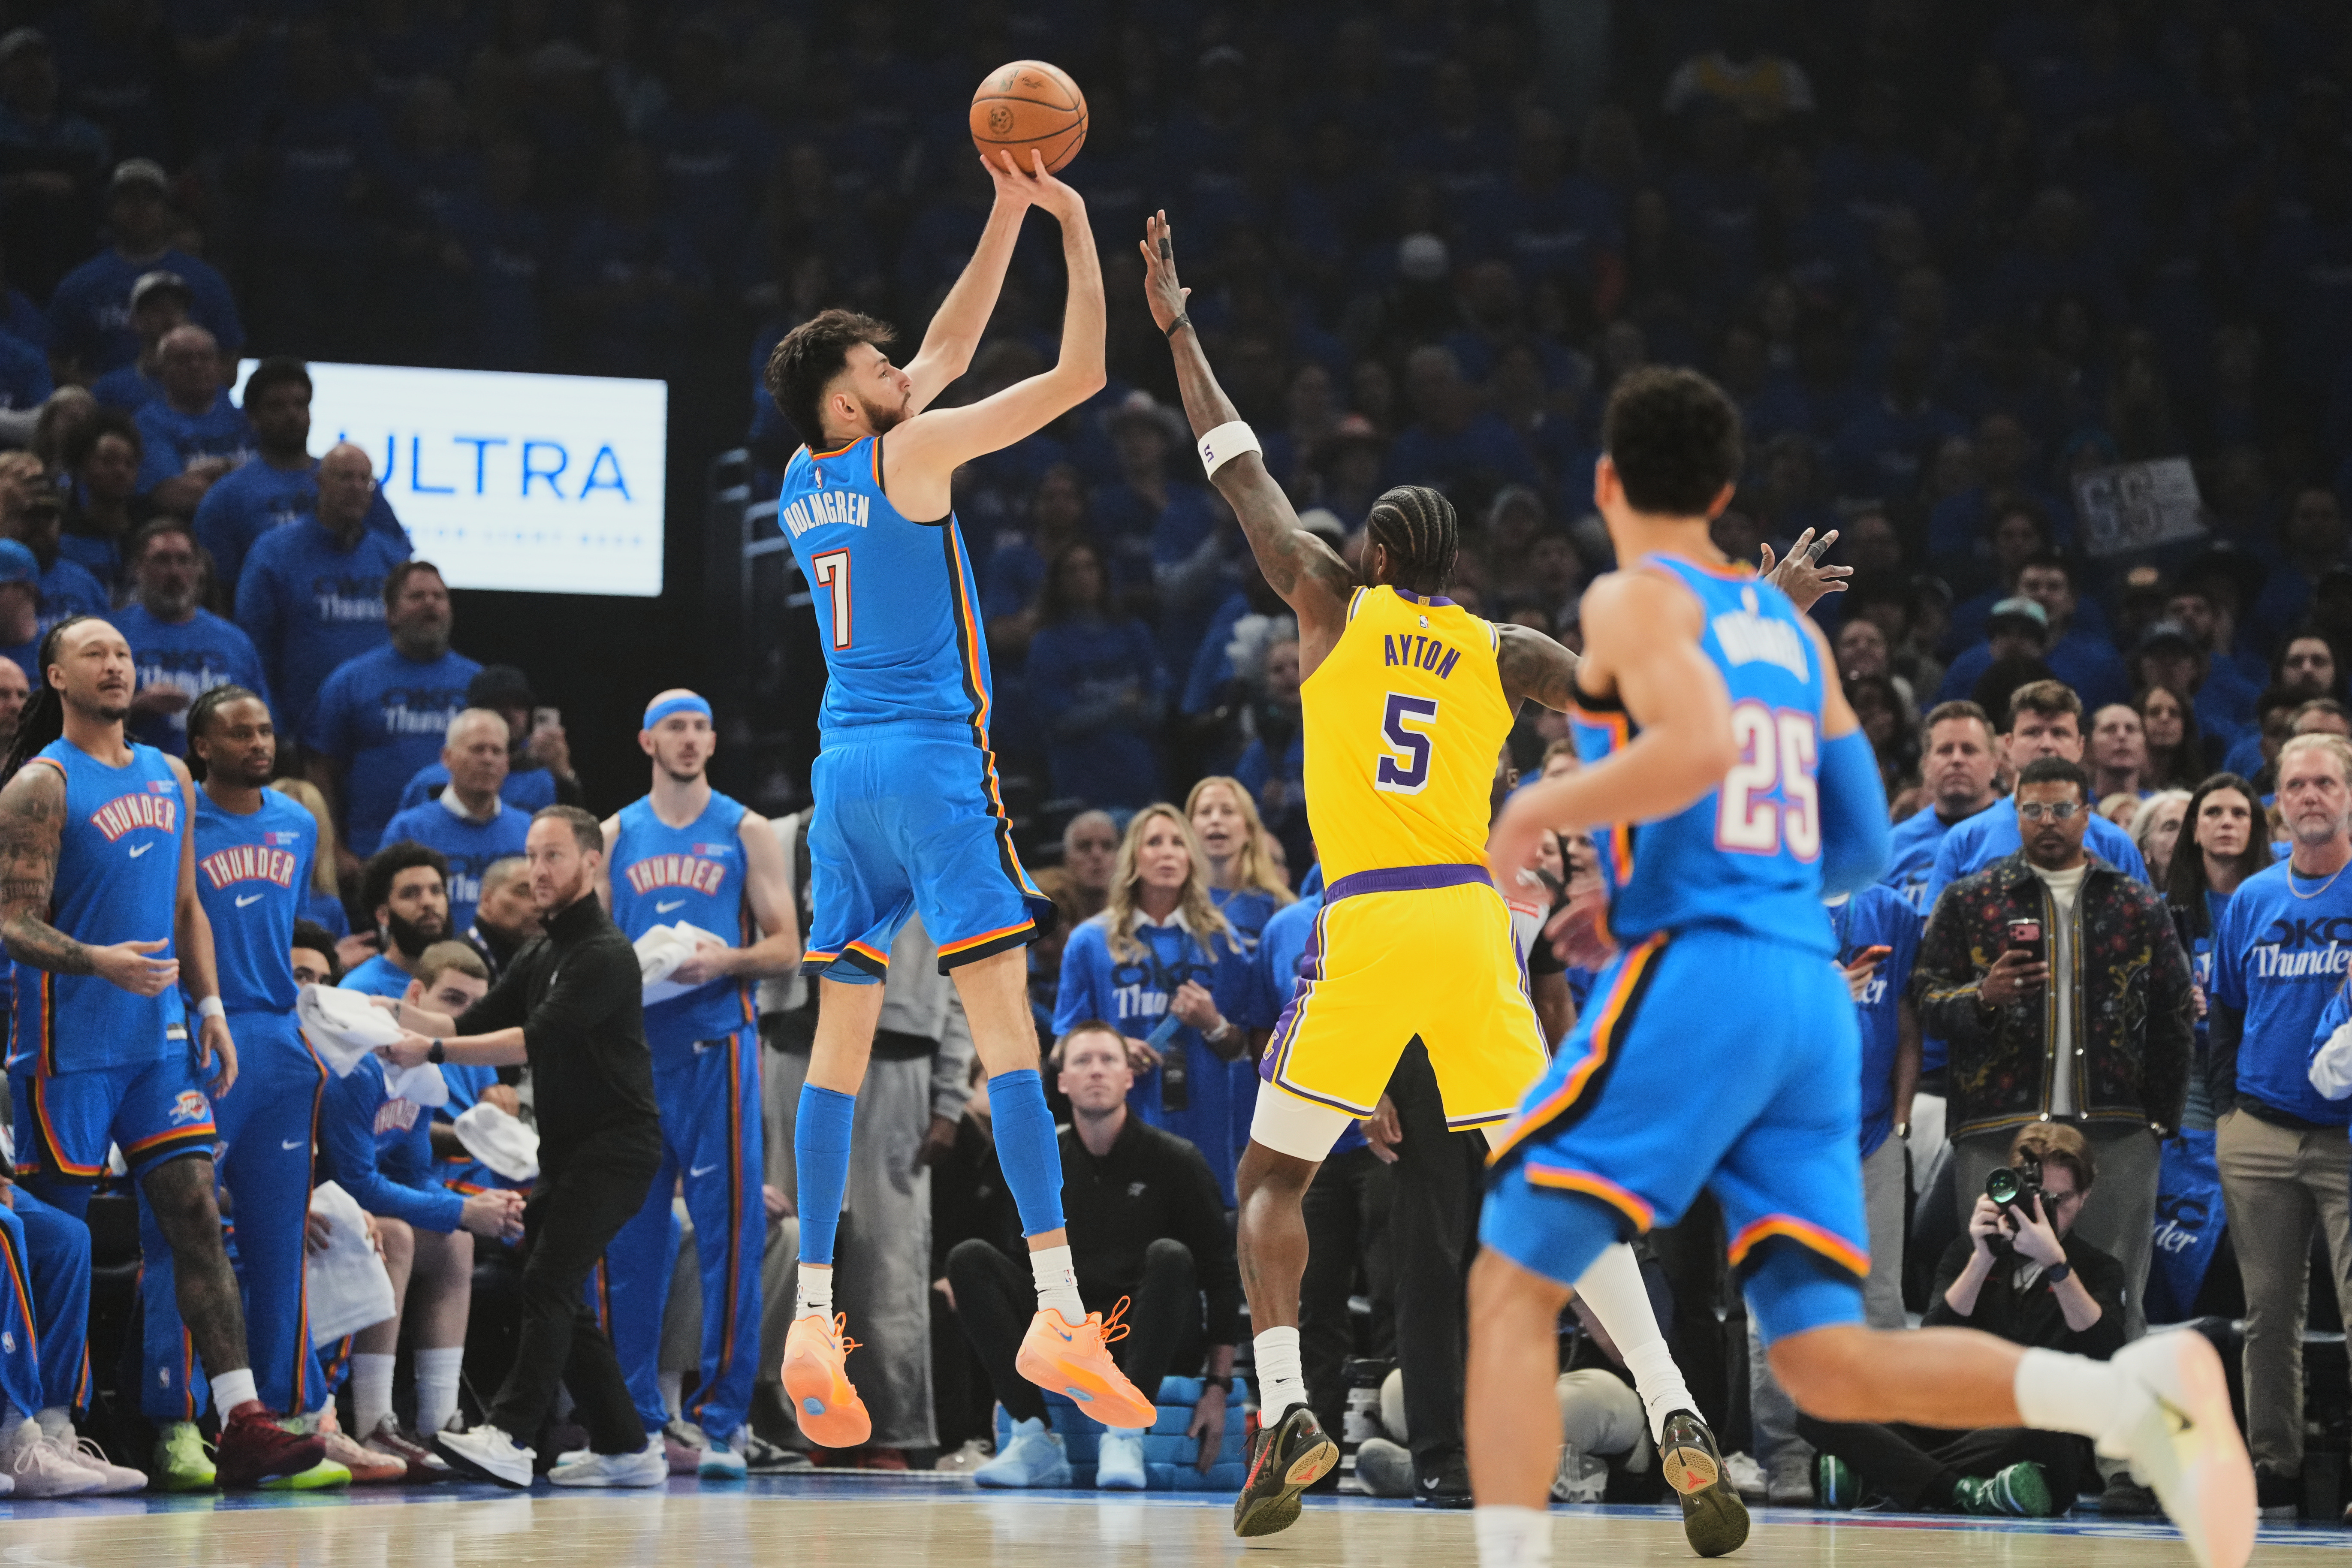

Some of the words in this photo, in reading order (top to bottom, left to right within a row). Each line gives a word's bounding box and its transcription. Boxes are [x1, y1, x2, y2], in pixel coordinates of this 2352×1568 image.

[1204, 444, 1214, 463] 5
[783, 491, 869, 539] HOLMGREN
[811, 546, 852, 651] 7
[1384, 634, 1461, 680] AYTON
[1374, 691, 1439, 796] 5
[1714, 697, 1821, 864] 25
[90, 793, 176, 843] THUNDER
[199, 843, 296, 890] THUNDER
[625, 853, 727, 897] THUNDER
[2252, 940, 2352, 977] Thunde
